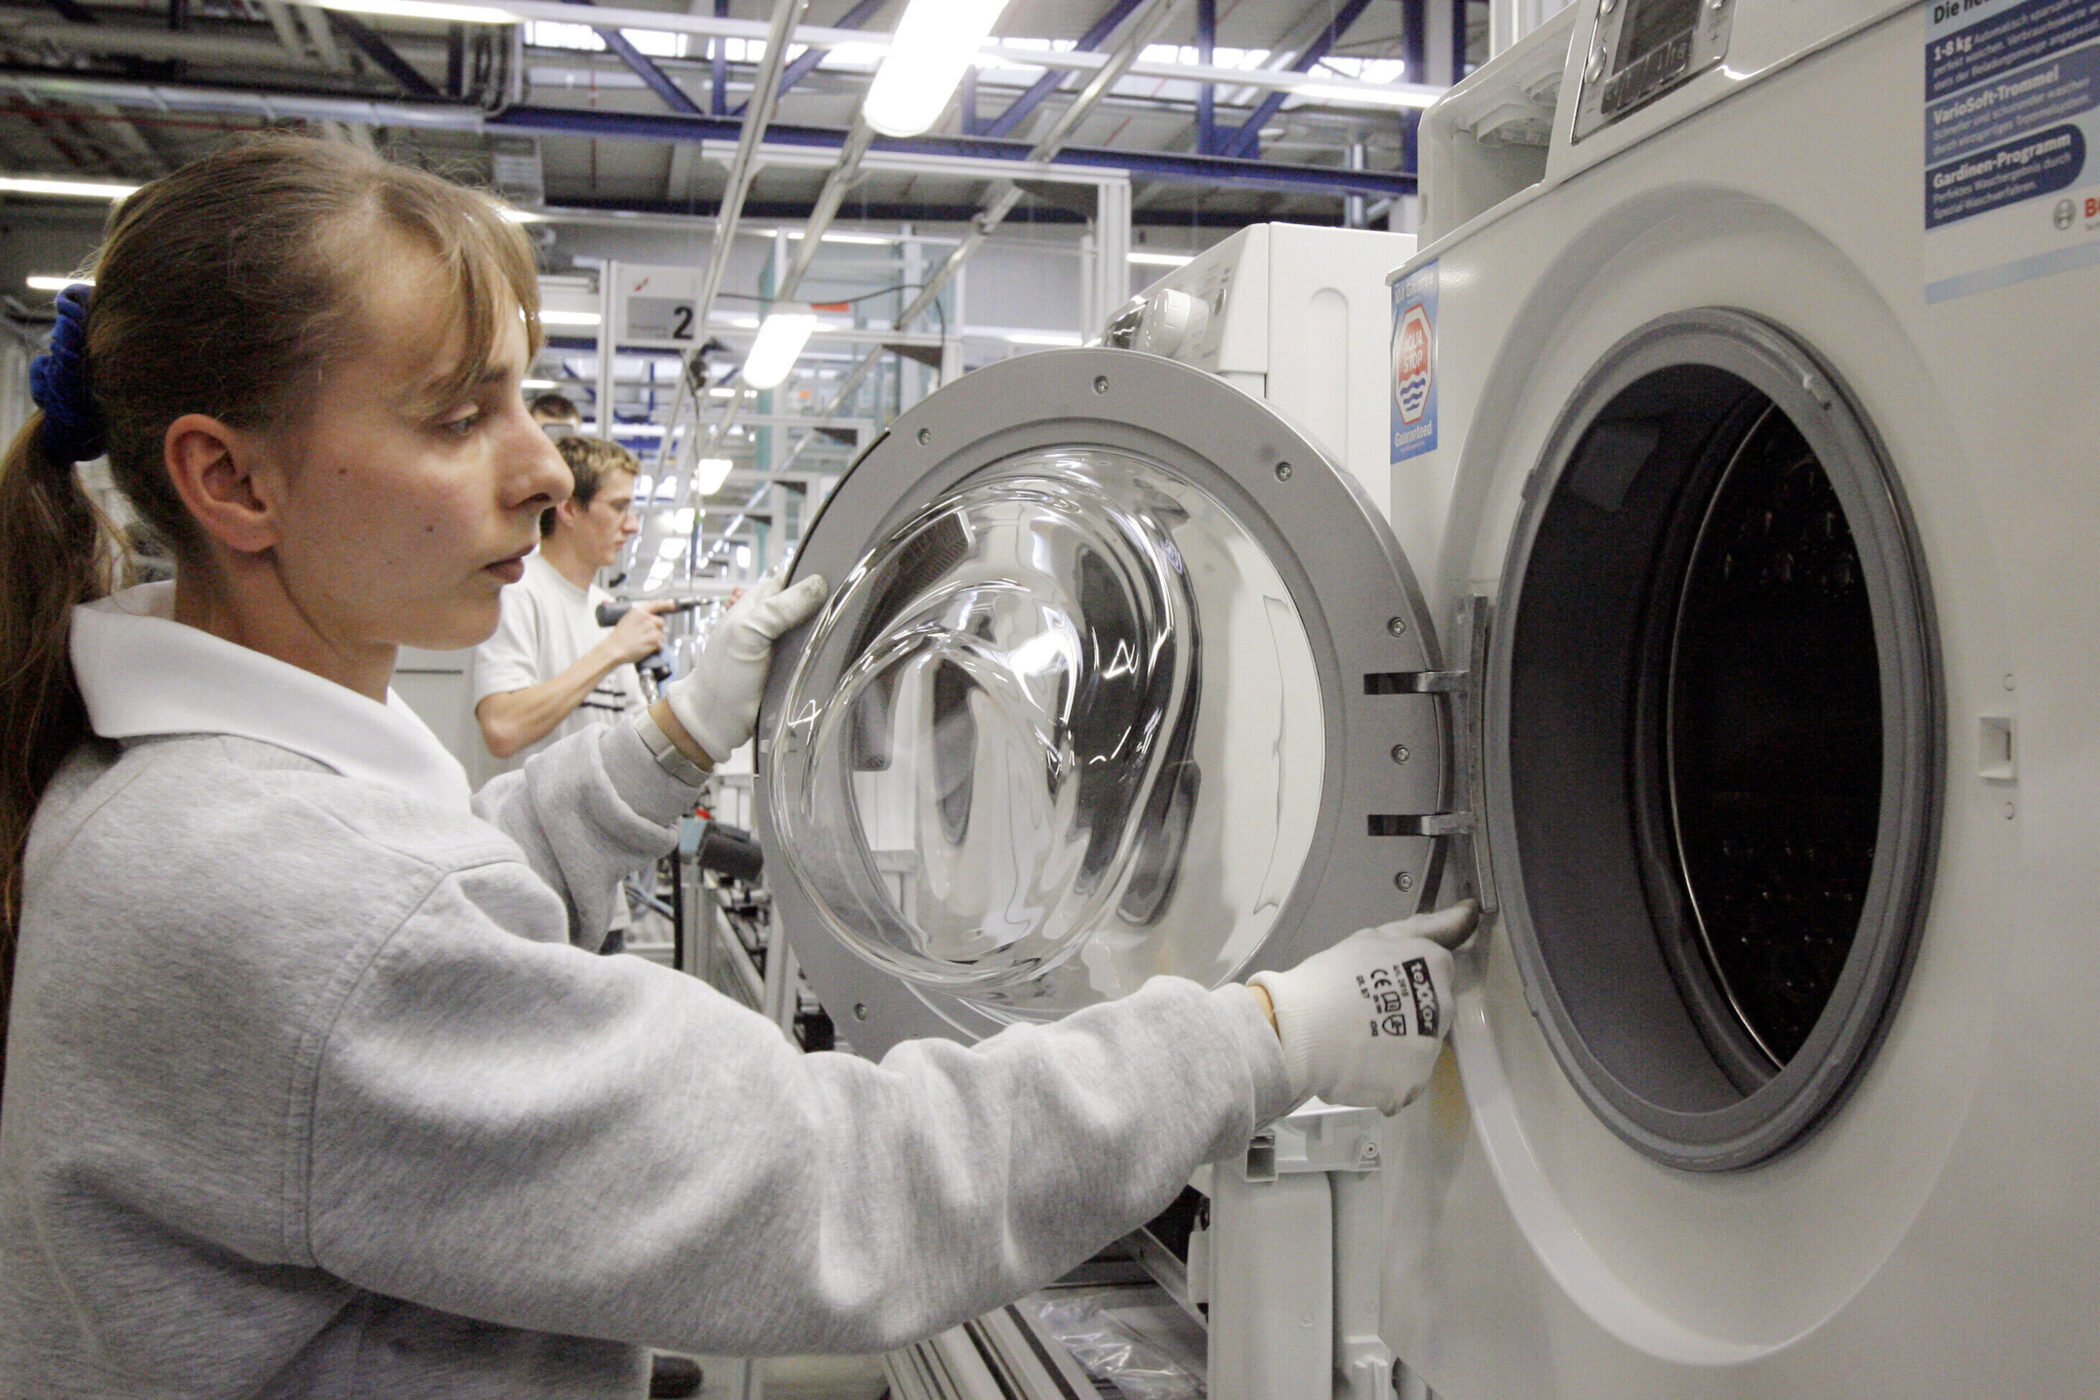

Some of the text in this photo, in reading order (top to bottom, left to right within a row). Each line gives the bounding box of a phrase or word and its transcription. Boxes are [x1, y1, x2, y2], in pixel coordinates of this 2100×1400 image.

[1934, 3, 1960, 25] Die
[1934, 40, 1955, 61] 1-8
[1956, 36, 1974, 54] kg
[1933, 64, 2060, 125] VarioSoft-Trommel
[1933, 133, 2072, 189] Gardinen-Programm
[673, 305, 694, 340] 2
[1403, 349, 1423, 374] STOP
